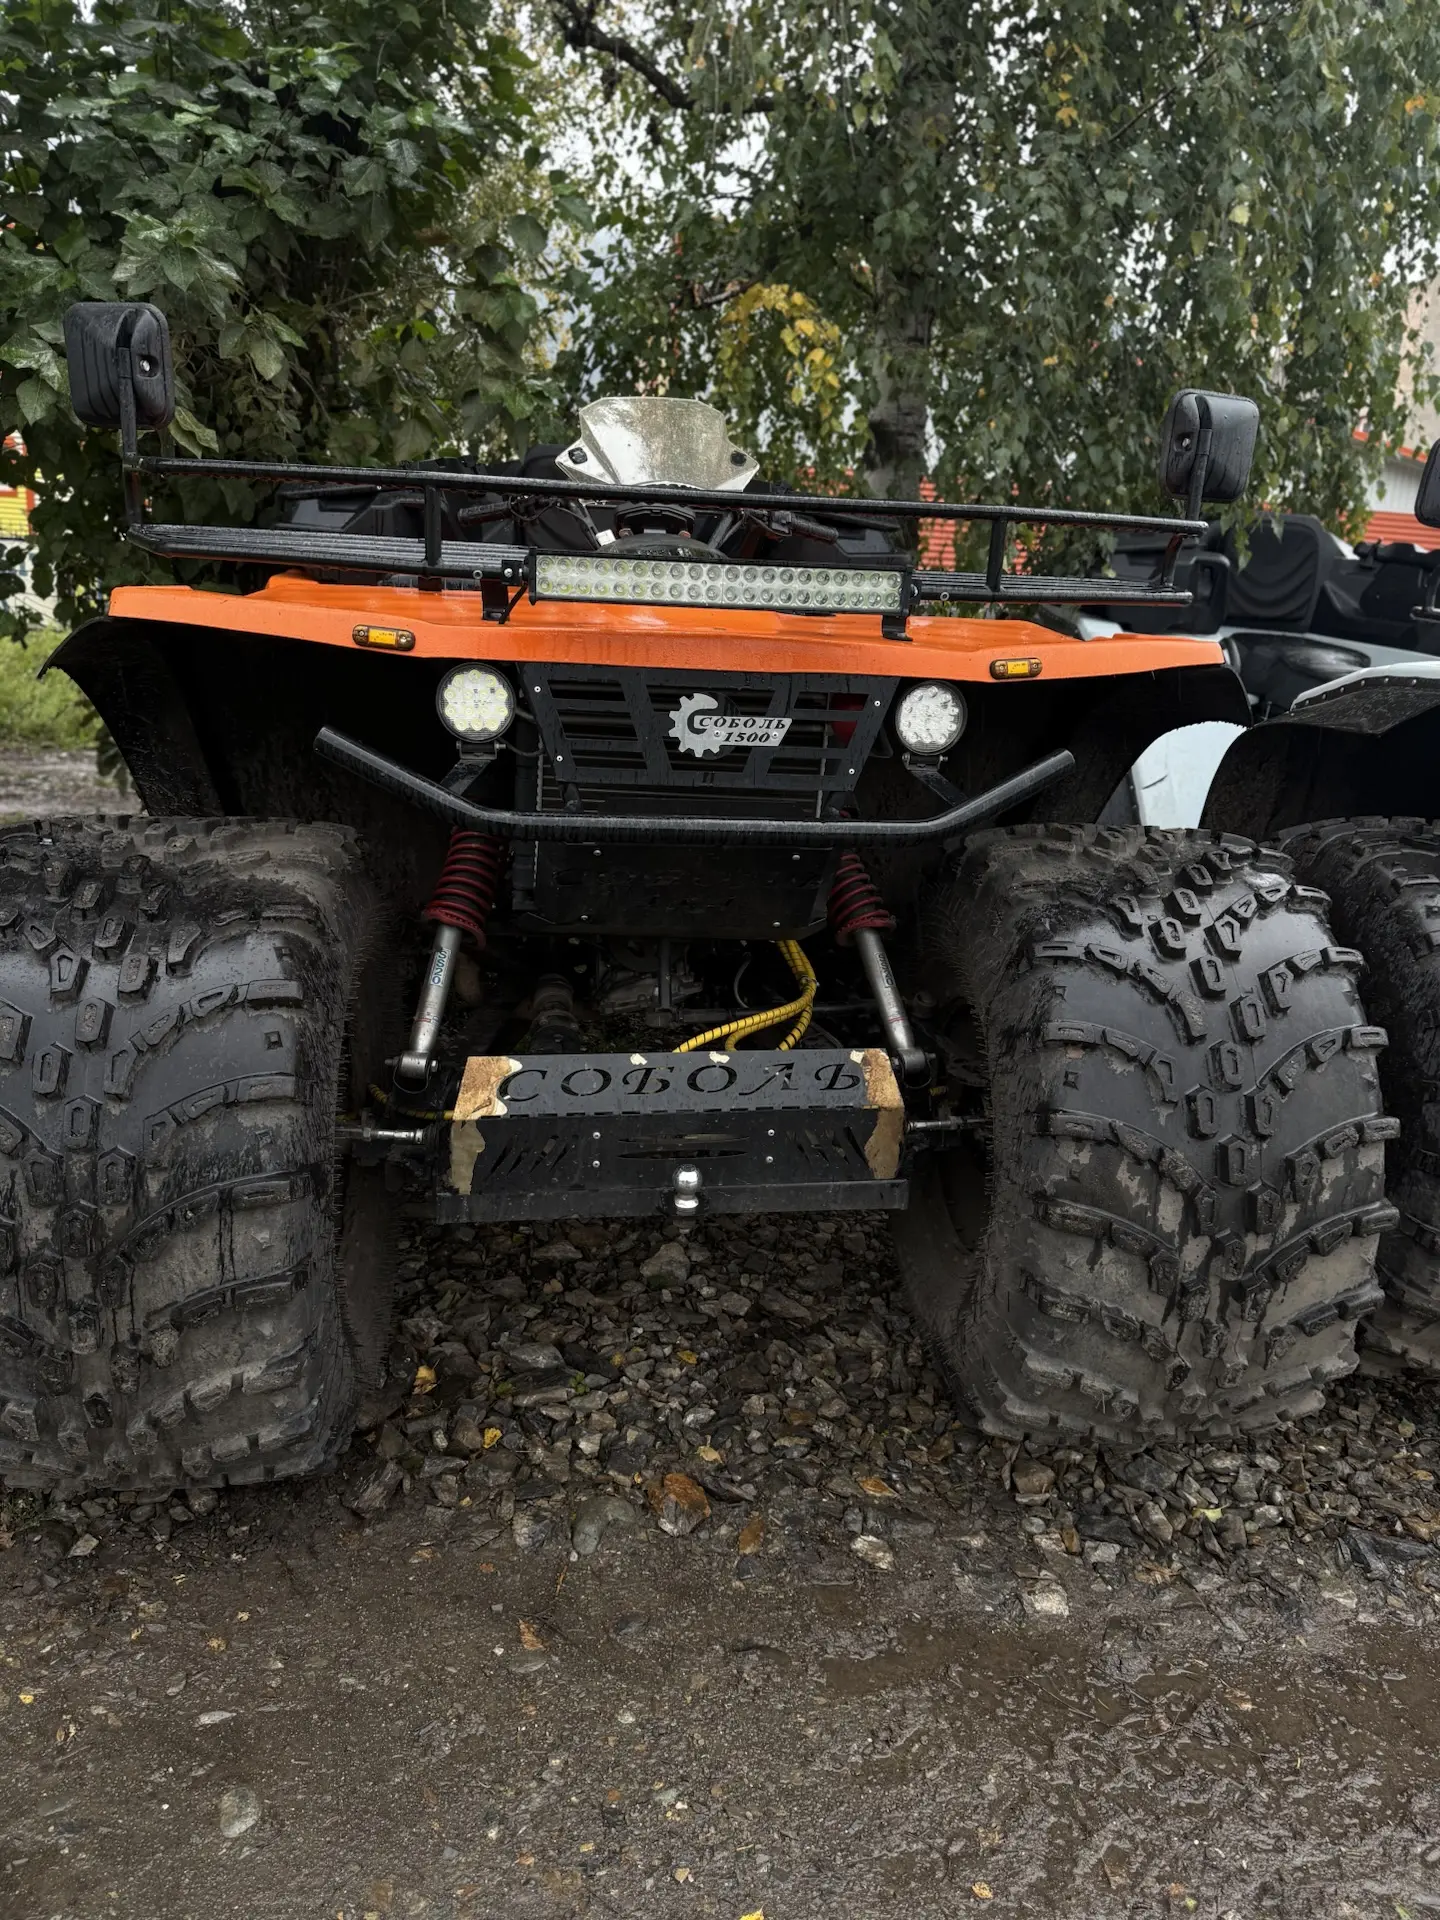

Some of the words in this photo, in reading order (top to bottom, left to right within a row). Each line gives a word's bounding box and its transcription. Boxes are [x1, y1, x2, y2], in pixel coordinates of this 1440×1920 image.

[699, 717, 786, 729] СОБОЛЬ
[723, 732, 771, 743] 1500
[432, 951, 447, 984] SS20
[498, 1062, 861, 1102] СОБОЛЬ
